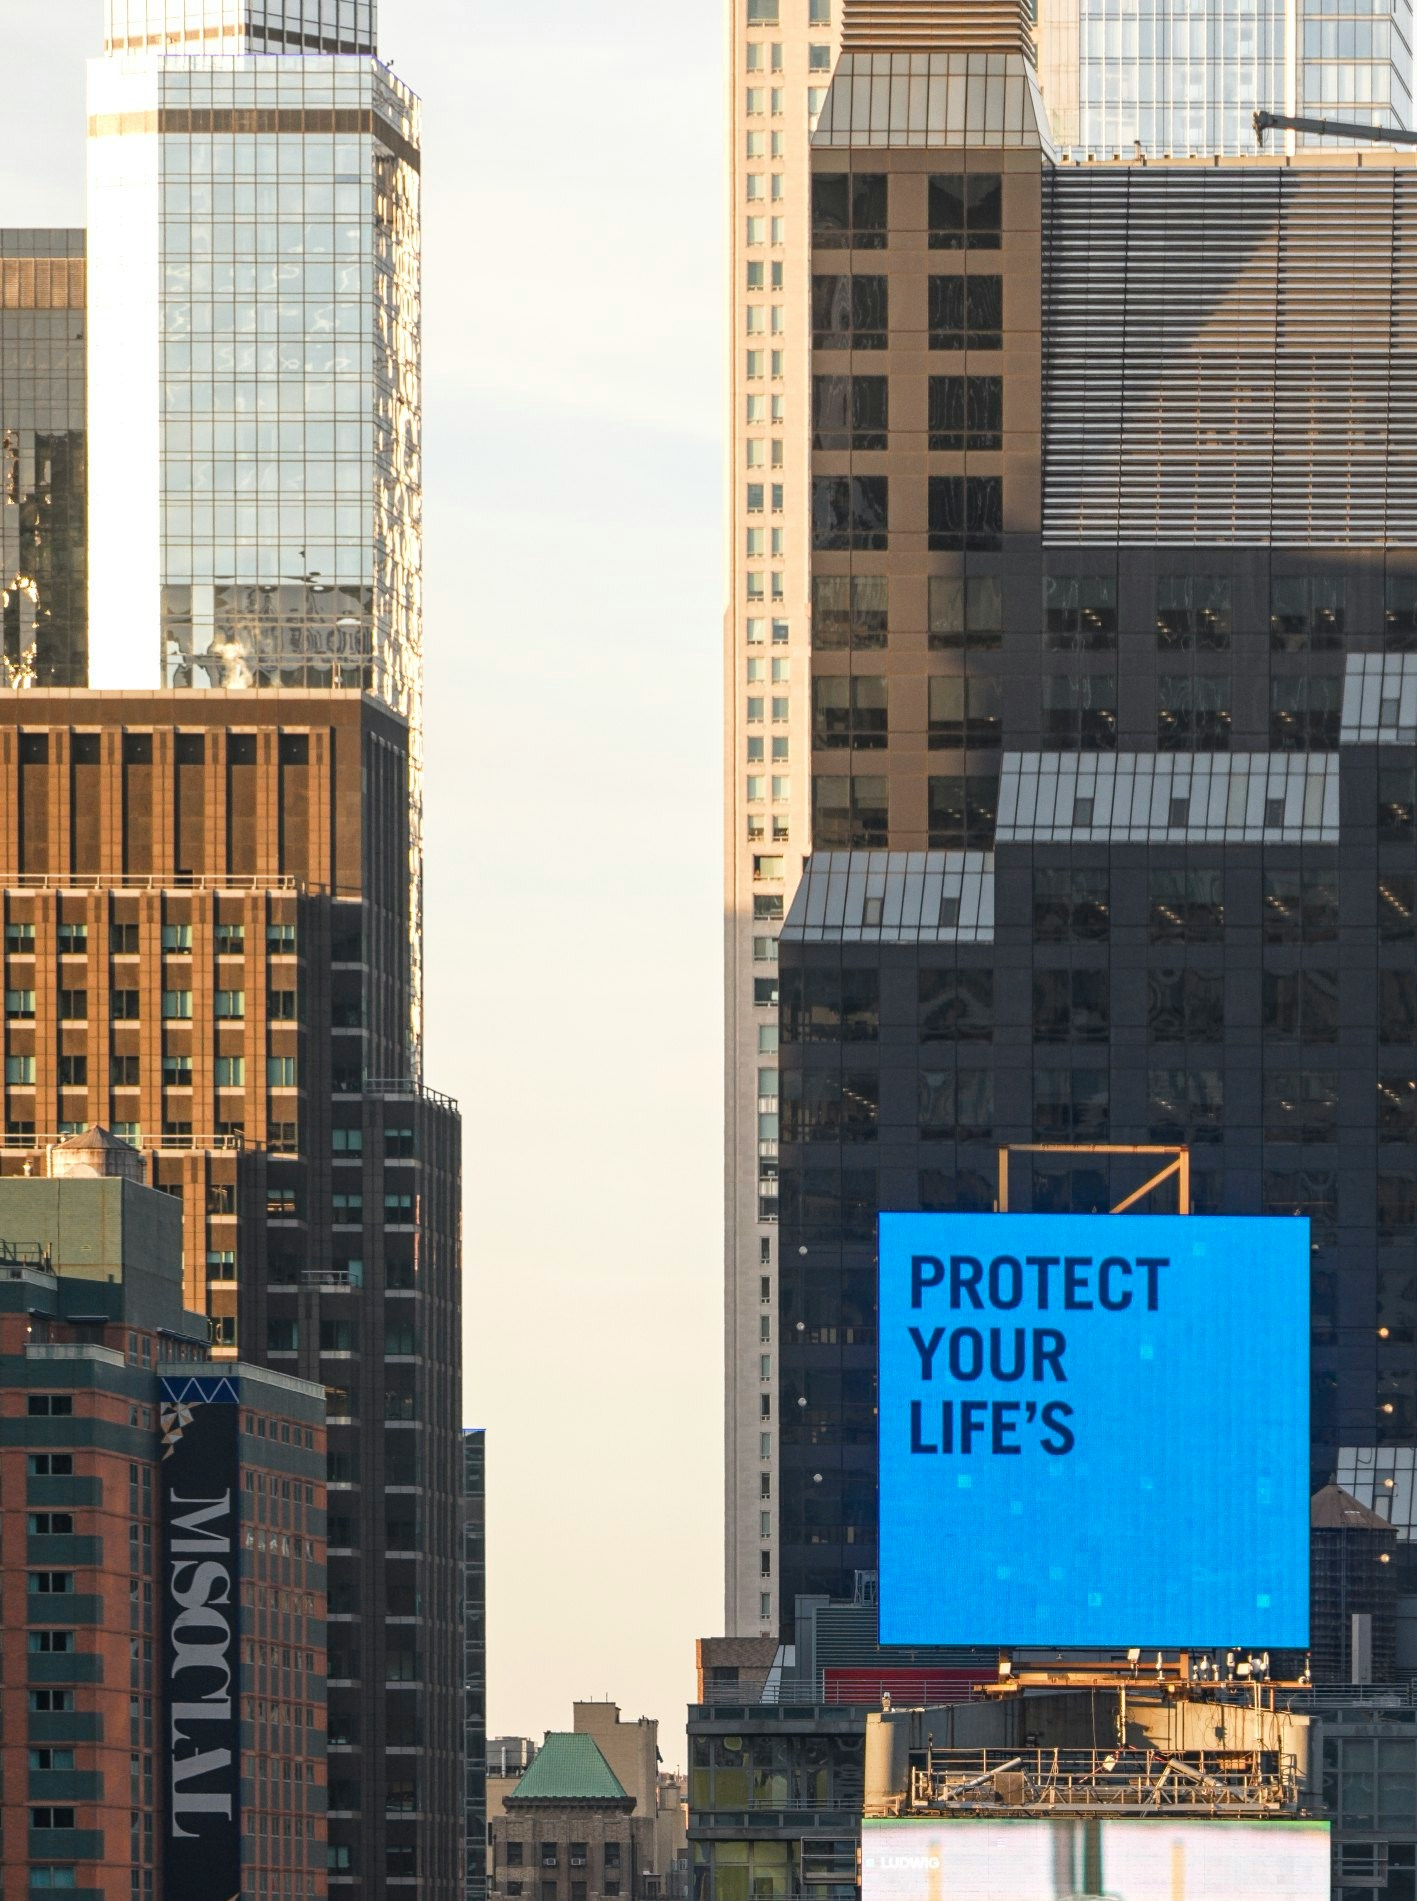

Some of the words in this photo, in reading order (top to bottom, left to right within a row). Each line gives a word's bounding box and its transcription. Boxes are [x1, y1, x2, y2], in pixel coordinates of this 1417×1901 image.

[910, 1255, 1170, 1311] PROTECT
[907, 1326, 1067, 1382] YOUR
[910, 1400, 1075, 1456] LIFE'S
[882, 1857, 940, 1869] LUDWIG
